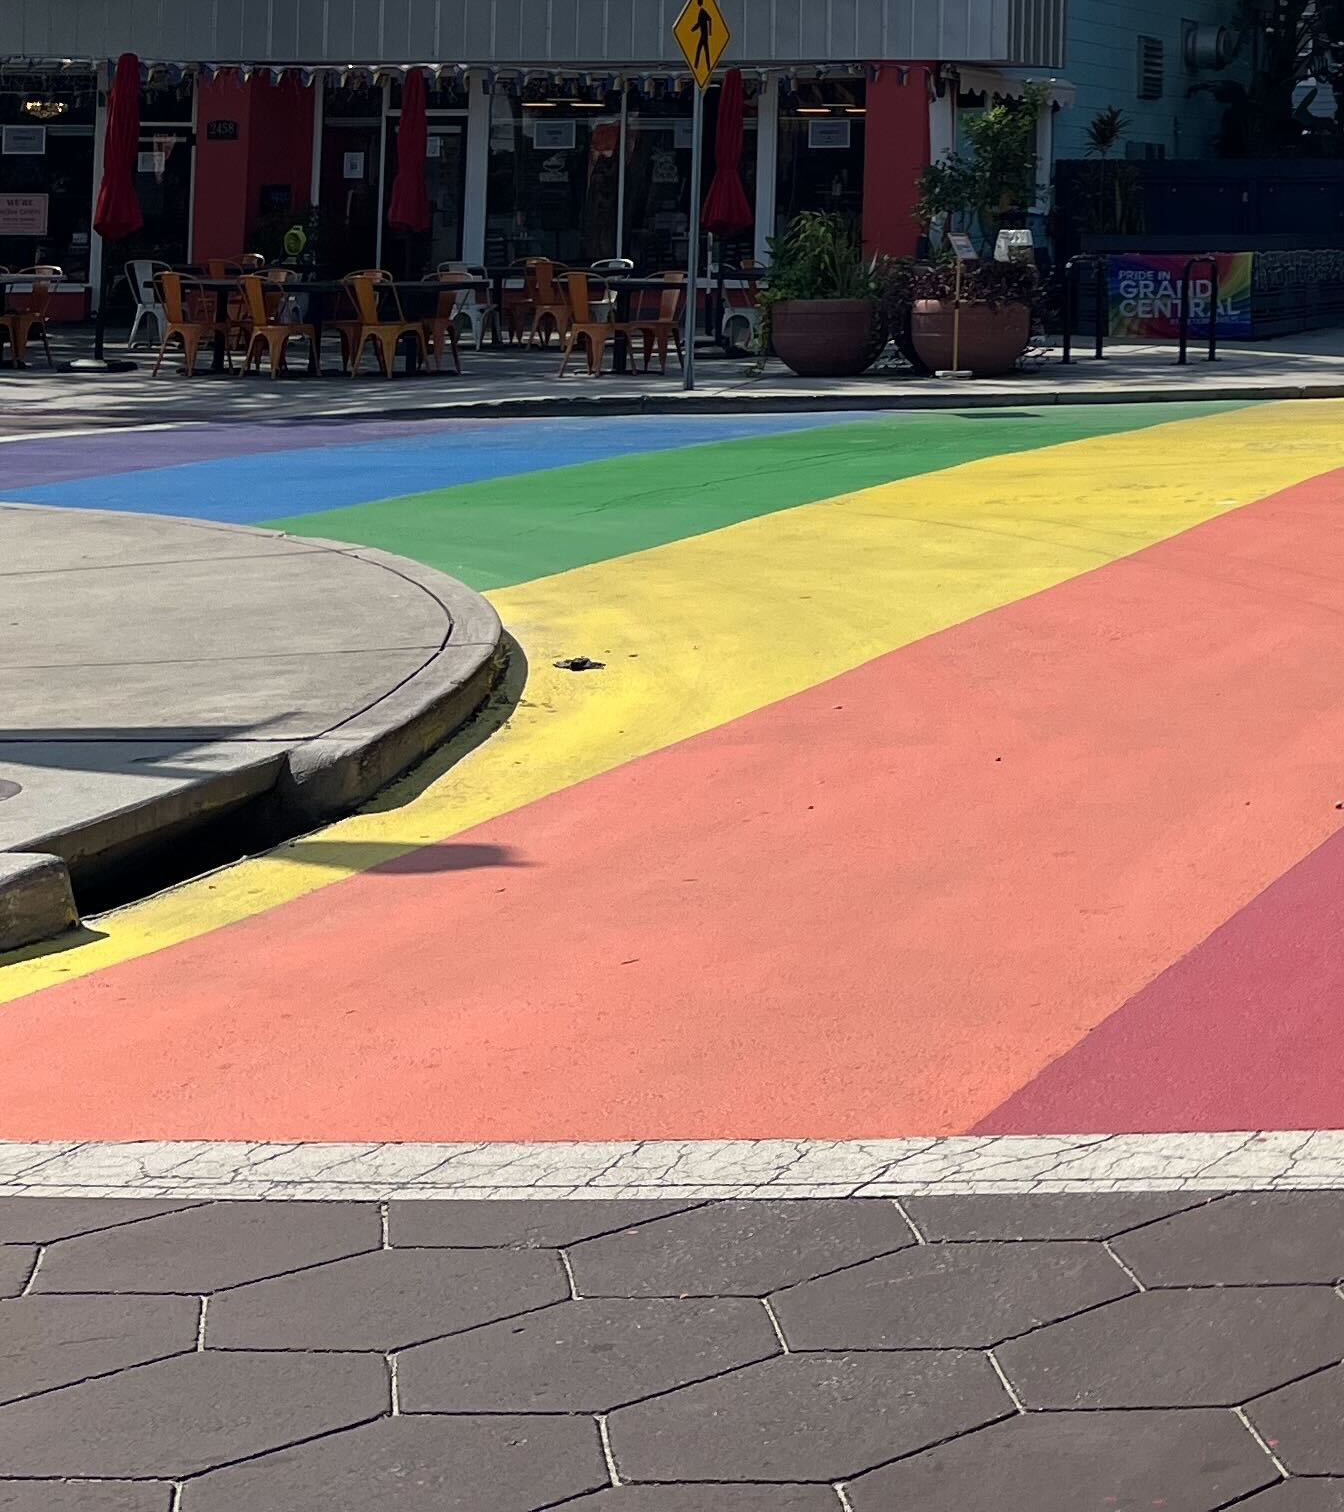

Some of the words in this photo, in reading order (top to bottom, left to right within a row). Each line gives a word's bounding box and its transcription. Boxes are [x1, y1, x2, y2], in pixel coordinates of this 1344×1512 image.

[207, 120, 236, 136] 2458
[1118, 270, 1154, 281] PRIDE
[1158, 270, 1172, 280] IN
[1119, 279, 1212, 299] GRAND
[1119, 297, 1241, 319] CENTRAL
